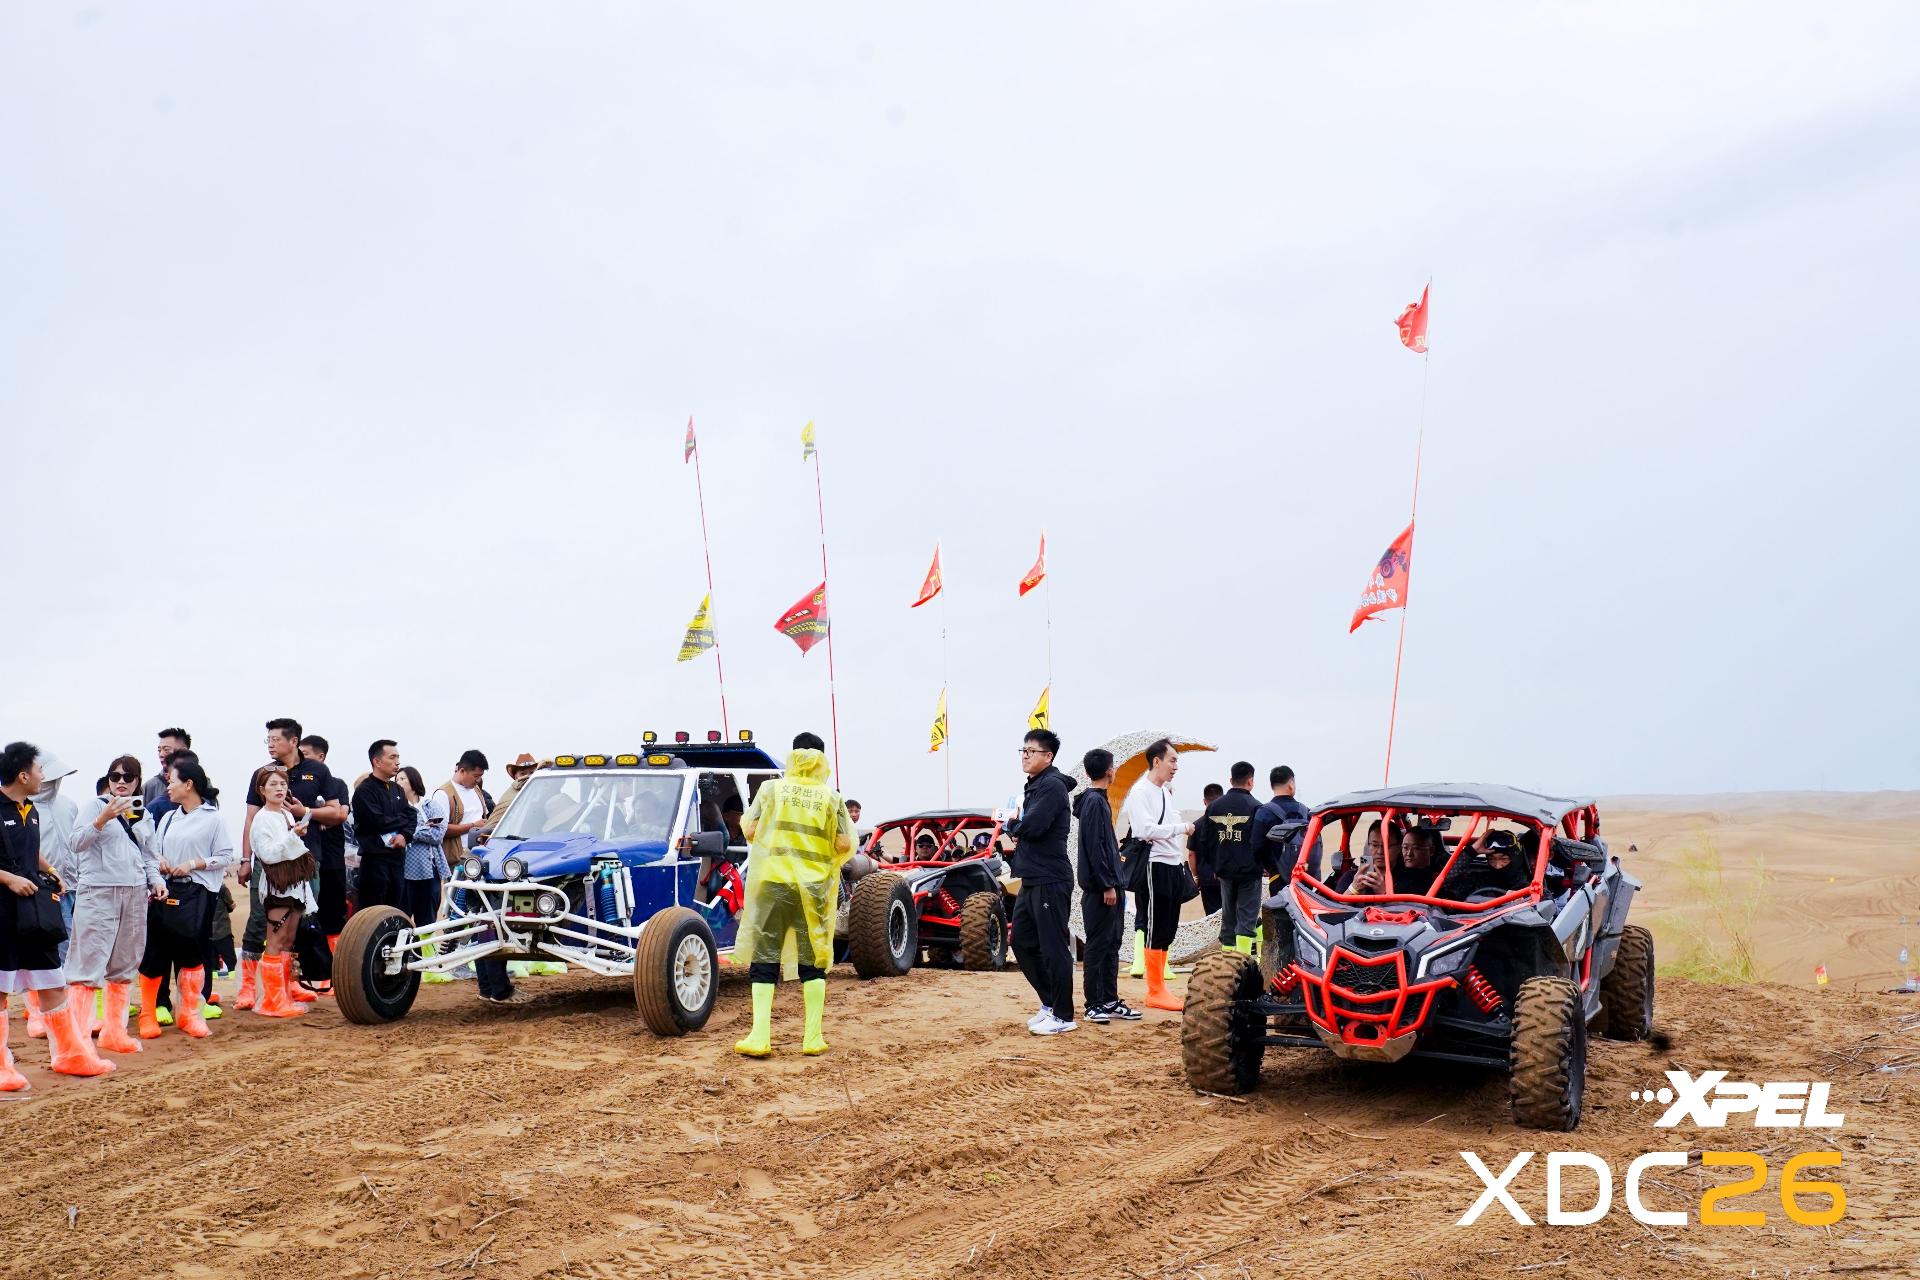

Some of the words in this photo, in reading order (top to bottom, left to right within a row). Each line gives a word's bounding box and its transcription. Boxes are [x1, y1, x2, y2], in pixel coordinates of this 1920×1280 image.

[780, 784, 824, 800] 文明出行
[781, 796, 823, 812] 平安回家
